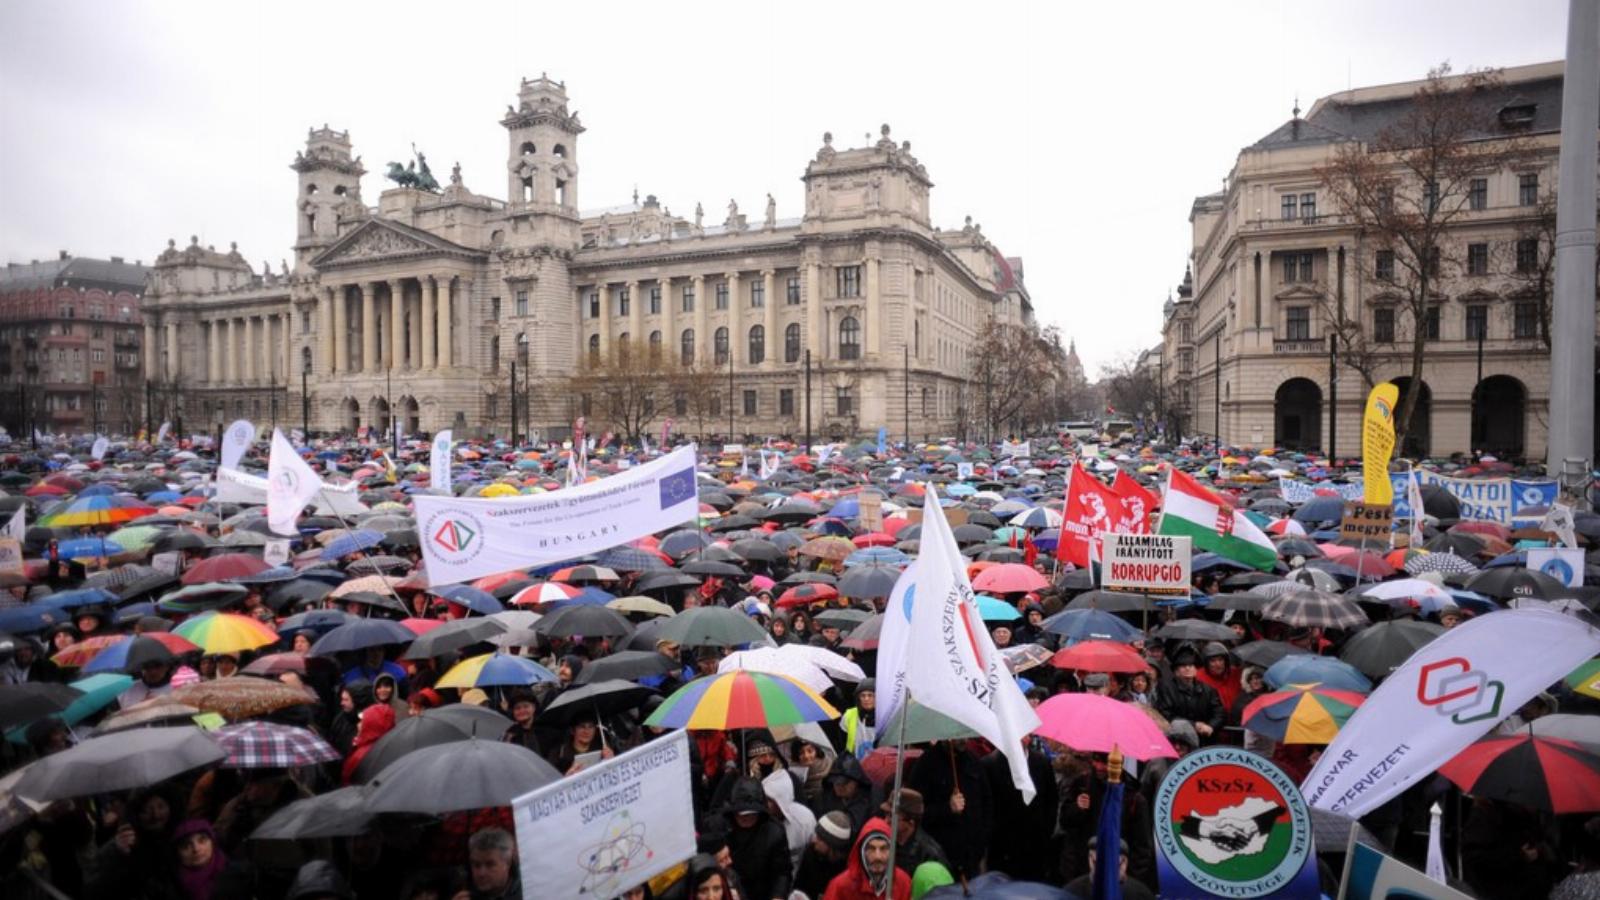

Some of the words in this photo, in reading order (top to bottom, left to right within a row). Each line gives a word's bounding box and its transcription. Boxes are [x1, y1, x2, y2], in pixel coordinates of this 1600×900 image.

[1354, 506, 1391, 520] Pest
[539, 525, 619, 548] HUNGARY
[1343, 521, 1390, 535] megye
[1513, 585, 1533, 596] citi
[1196, 777, 1257, 794] KSzSz
[1308, 748, 1359, 807] MAGYAR
[1159, 753, 1213, 856] KÖZSZOLGÁLATI
[1215, 751, 1306, 857] SZAKSZERVEZETEK
[1189, 871, 1285, 897] SZÖVETSÉGE
